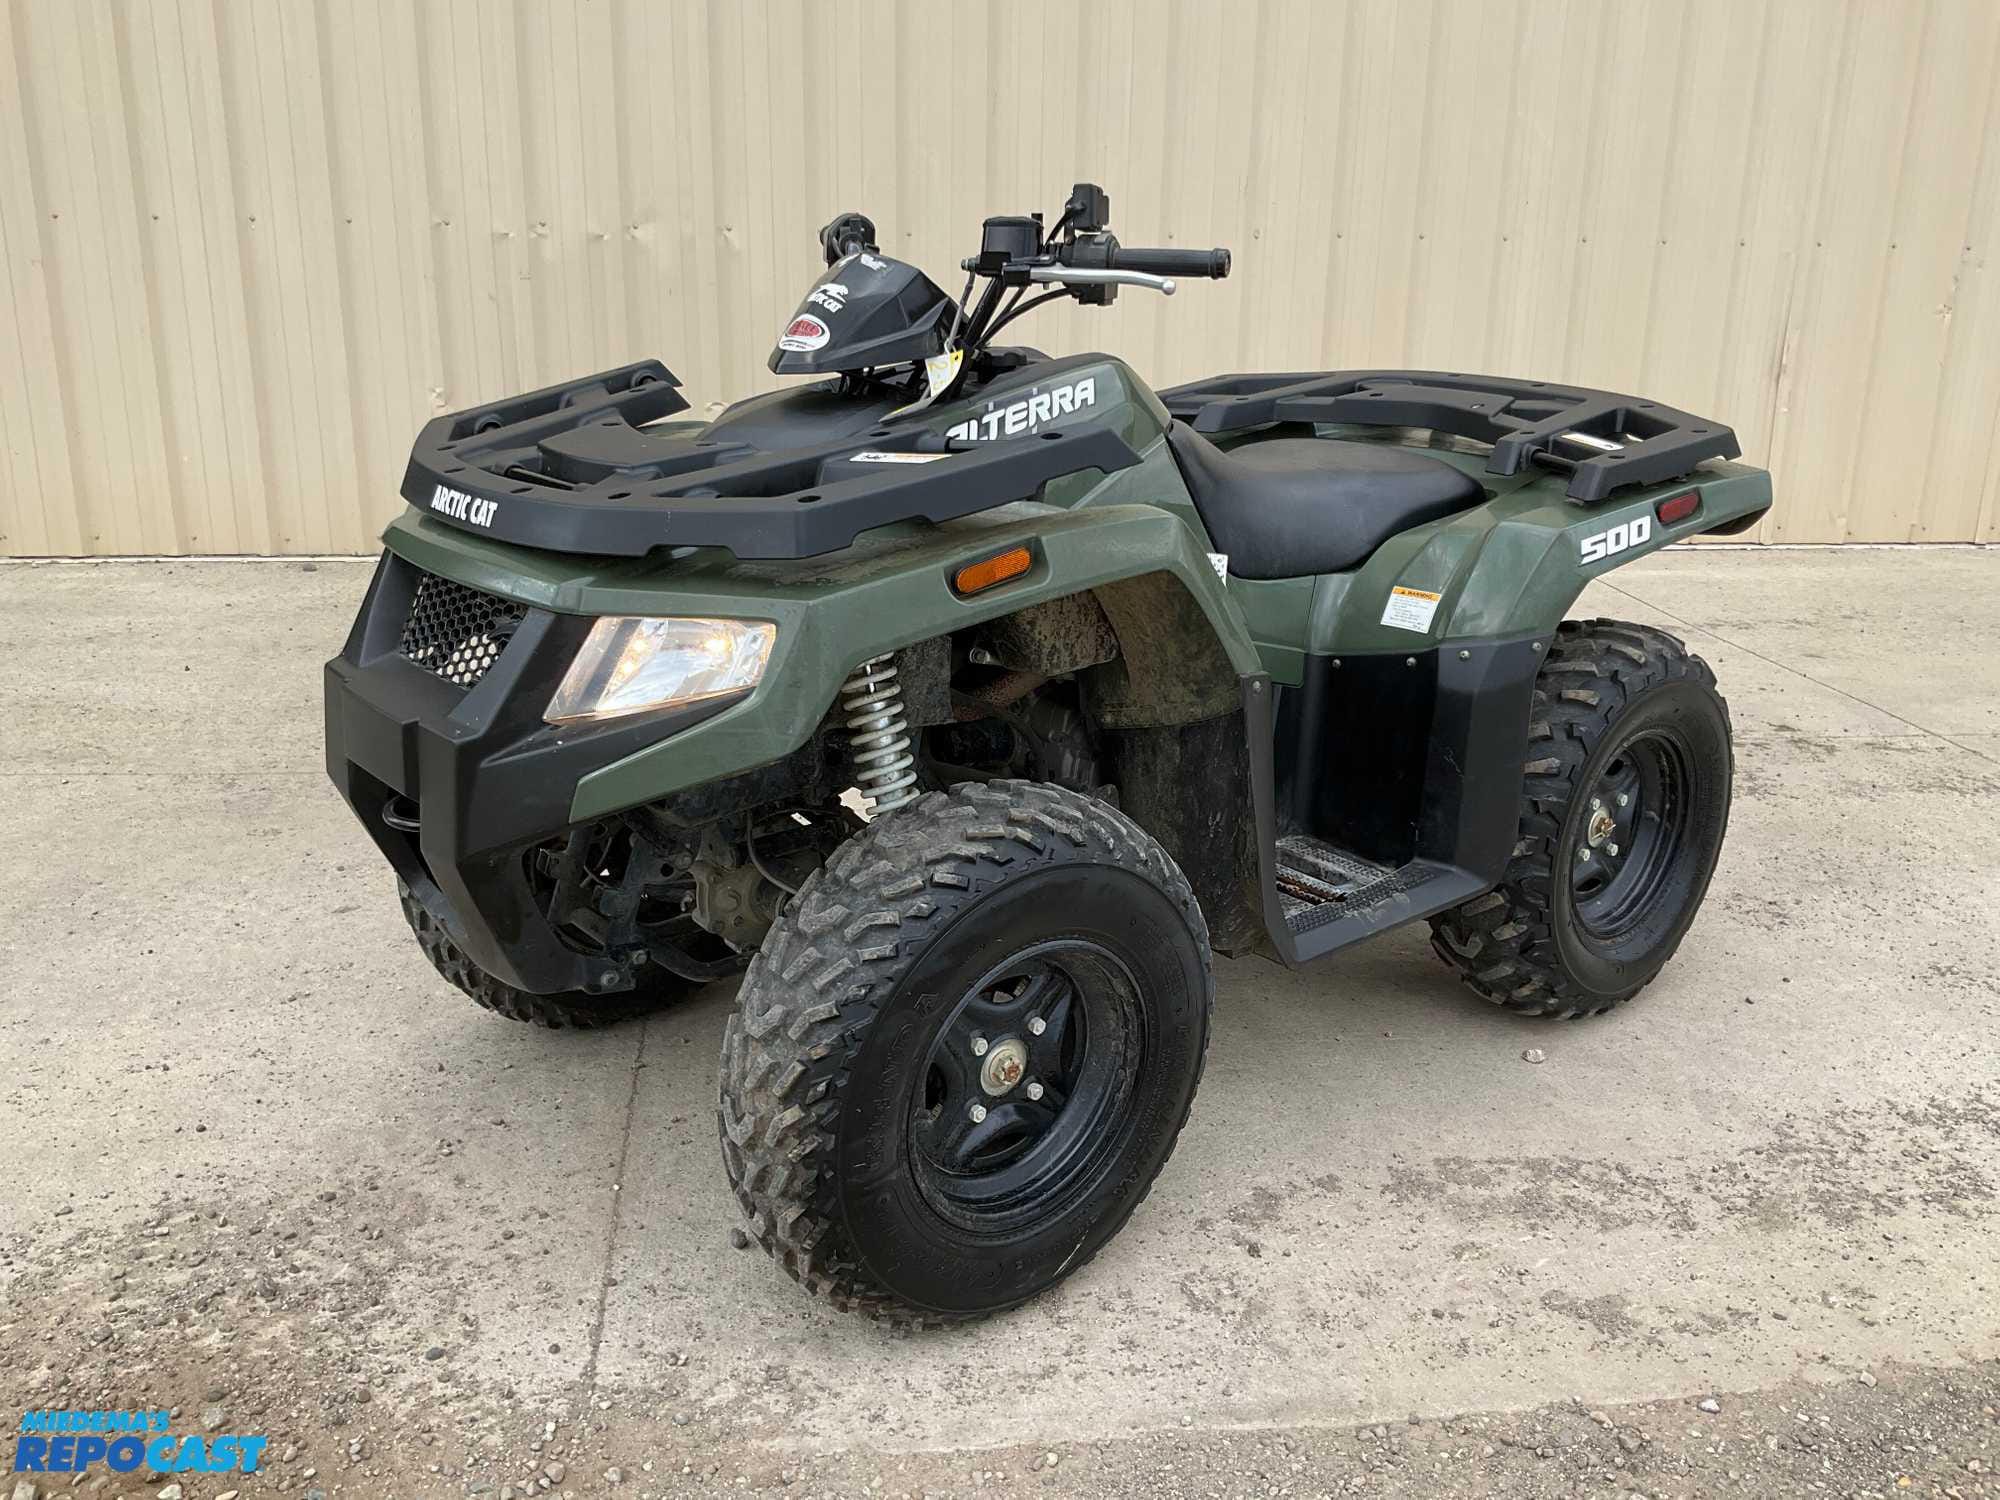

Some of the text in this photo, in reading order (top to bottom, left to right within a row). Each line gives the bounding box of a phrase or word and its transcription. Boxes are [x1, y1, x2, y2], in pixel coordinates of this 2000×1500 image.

[431, 484, 499, 528] ARCTIC CAT
[1580, 515, 1651, 565] 500
